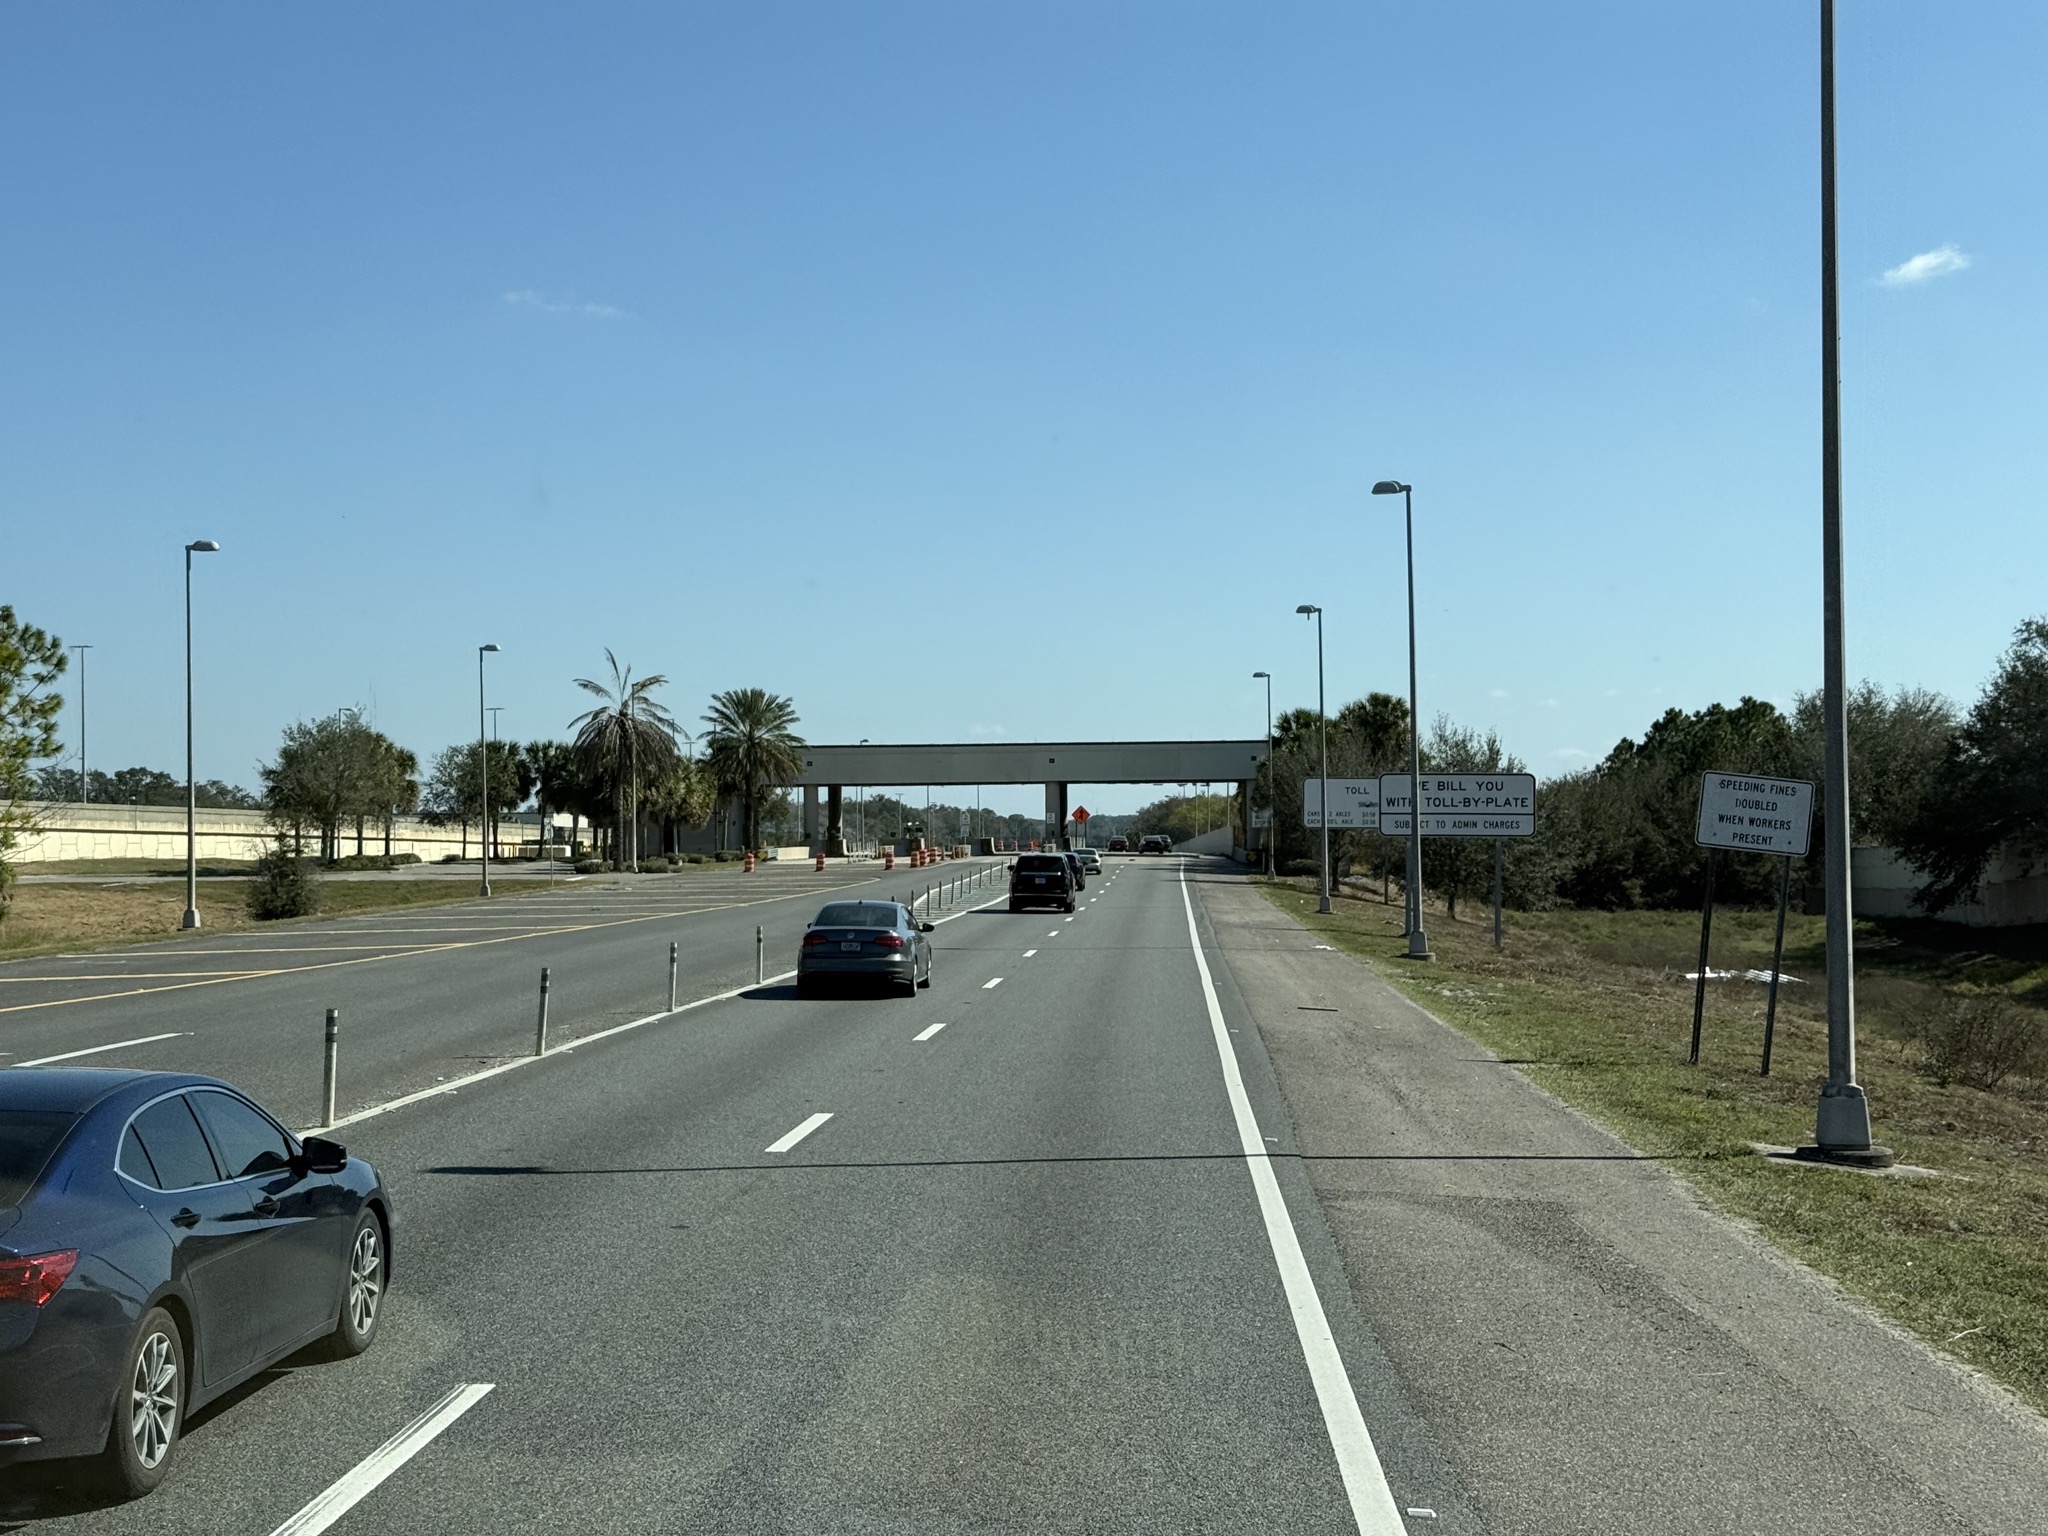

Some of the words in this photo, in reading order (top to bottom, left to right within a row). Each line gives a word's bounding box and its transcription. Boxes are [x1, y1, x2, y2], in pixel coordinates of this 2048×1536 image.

[1345, 786, 1370, 795] TOLL
[1437, 781, 1467, 791] BILL
[1475, 781, 1504, 791] YOU
[1719, 780, 1766, 793] SPEEDING
[1770, 784, 1797, 797] FINES
[1425, 797, 1529, 808] TOLL-BY-PLATE
[1735, 798, 1778, 812] DOUBLED
[1394, 820, 1429, 829] SUBCT
[1436, 820, 1446, 829] TO
[1452, 820, 1478, 829] ADMIN
[1483, 820, 1520, 830] CHARGES
[1718, 814, 1744, 826] WHEN
[1748, 817, 1792, 831] WORKERS
[1731, 832, 1774, 846] PRESENT
